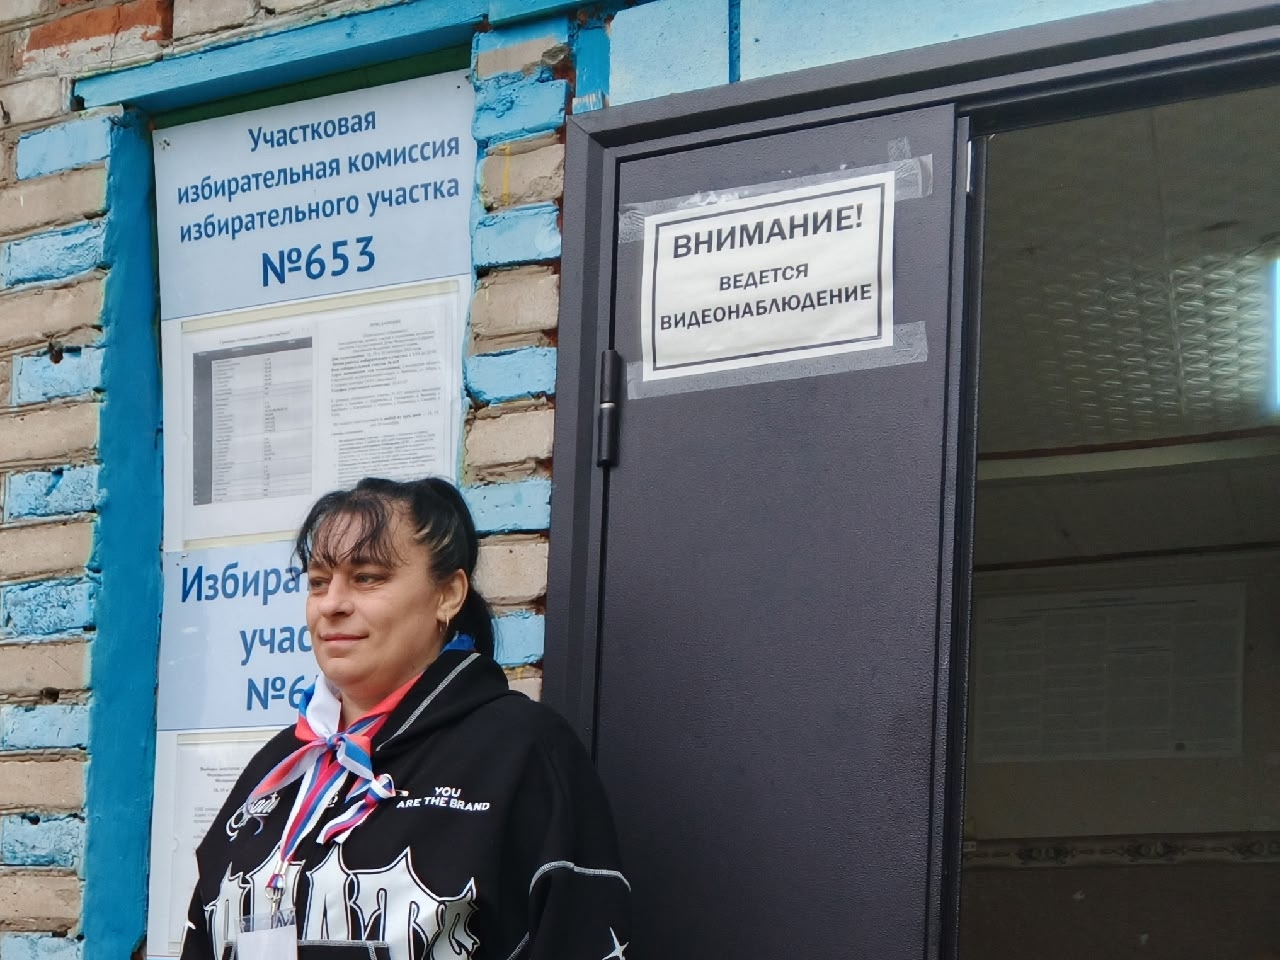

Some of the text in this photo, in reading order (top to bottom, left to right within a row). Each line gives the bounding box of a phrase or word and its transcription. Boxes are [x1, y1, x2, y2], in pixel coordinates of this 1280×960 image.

[247, 110, 376, 152] Участковая
[177, 136, 460, 205] избирательная комиссия
[180, 177, 460, 243] избирательного участка
[673, 203, 863, 259] ВНИМАНИЕ!
[262, 235, 376, 287] №653
[719, 263, 809, 291] ВЕДЕТСЯ
[660, 283, 872, 330] ВИДЕОНАБЛЮДЕНИЕ
[181, 561, 309, 606] Избира
[239, 625, 313, 667] учас
[246, 674, 310, 711] №6
[396, 796, 491, 812] ARE THE BRAND
[435, 786, 462, 798] YOU
